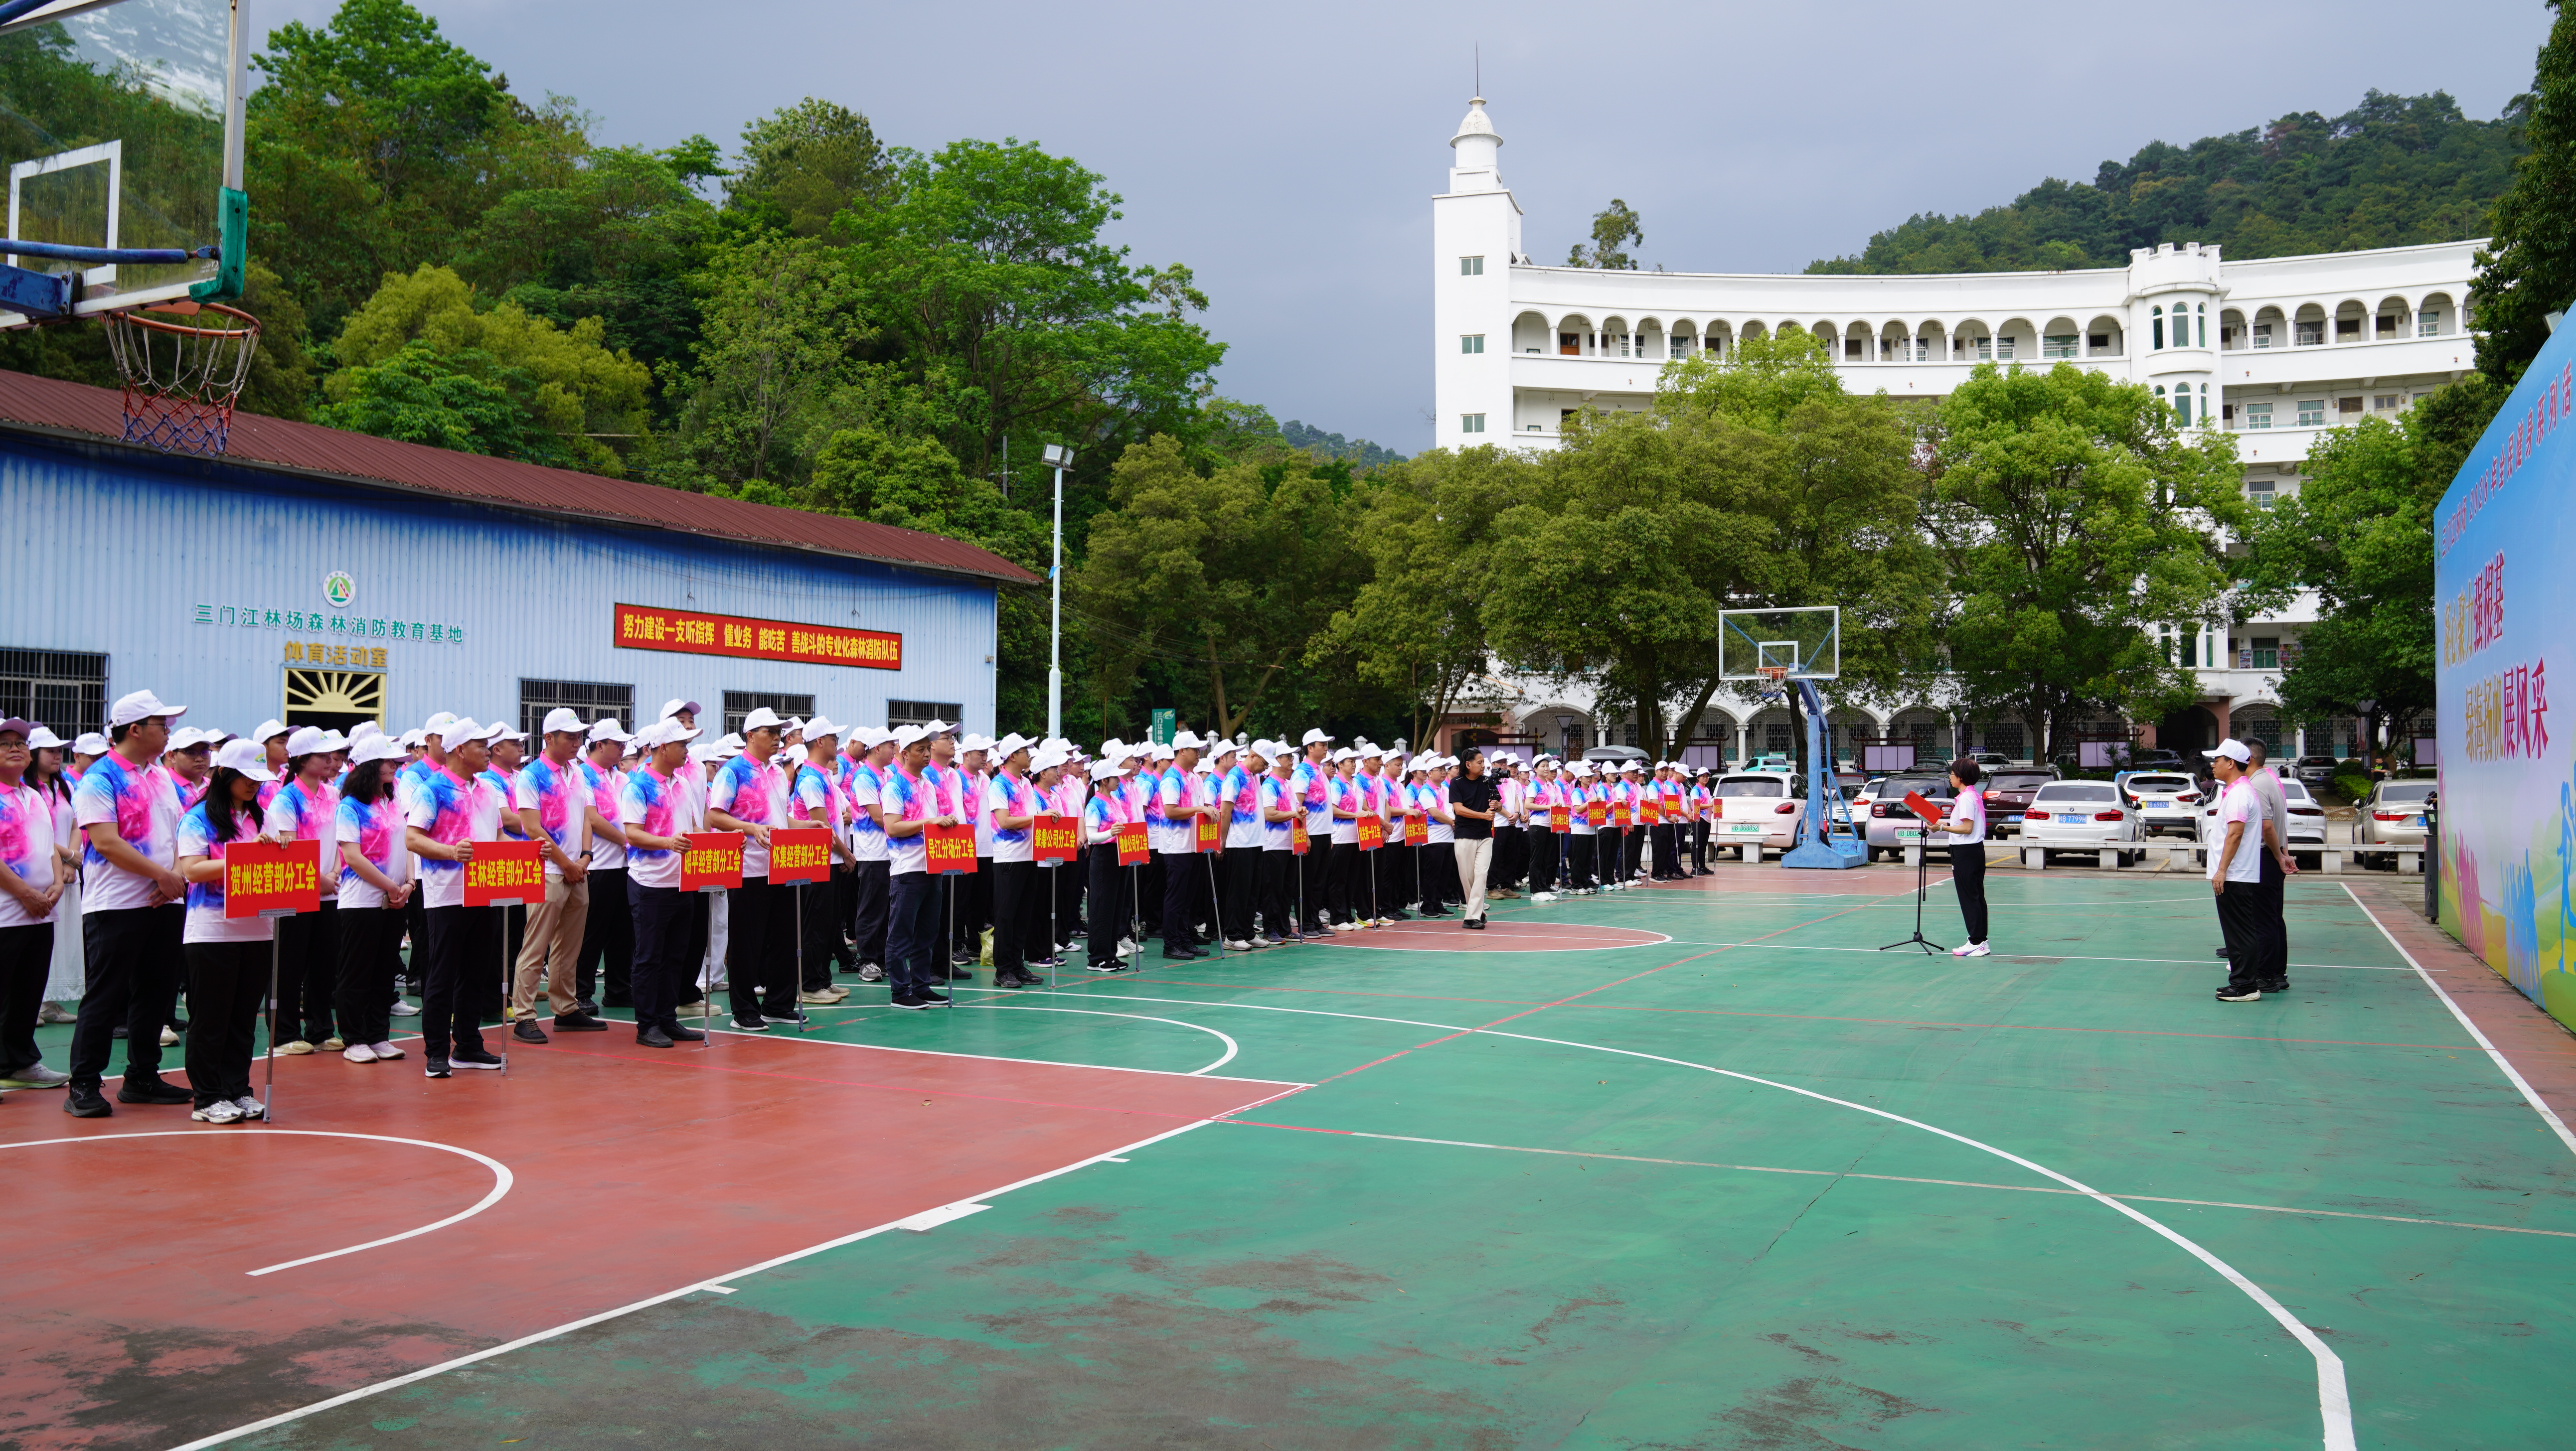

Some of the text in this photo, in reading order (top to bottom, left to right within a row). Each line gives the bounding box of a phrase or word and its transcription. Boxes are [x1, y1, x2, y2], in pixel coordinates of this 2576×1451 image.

[2444, 550, 2505, 669] 凝心聚力强根基
[195, 604, 463, 643] 三门江林场森林消防教育基地
[624, 613, 898, 661] 努力建设一支听指挥 懂业务 能吃苦 善战斗的专业化森林消防队伍
[285, 641, 387, 667] 体育活动室
[2465, 656, 2548, 763] 绿海扬帆展风采
[1552, 814, 1568, 825] 江口分场分工会
[1640, 806, 1658, 820] 绿化中心分工会
[1035, 828, 1076, 849] 肇鼎公司分工会
[1359, 824, 1381, 841] 机关第一分工会
[1406, 822, 1427, 837] 机关第二分工会
[928, 838, 974, 860] 导江分场分工会
[1119, 833, 1148, 854] 物业公司分工会
[684, 848, 741, 874] 昭平经营部分工会
[773, 844, 828, 869] 怀集经营部分工会
[231, 860, 316, 897] 贺州经营部分工会
[468, 859, 542, 887] 玉林经营部分工会
